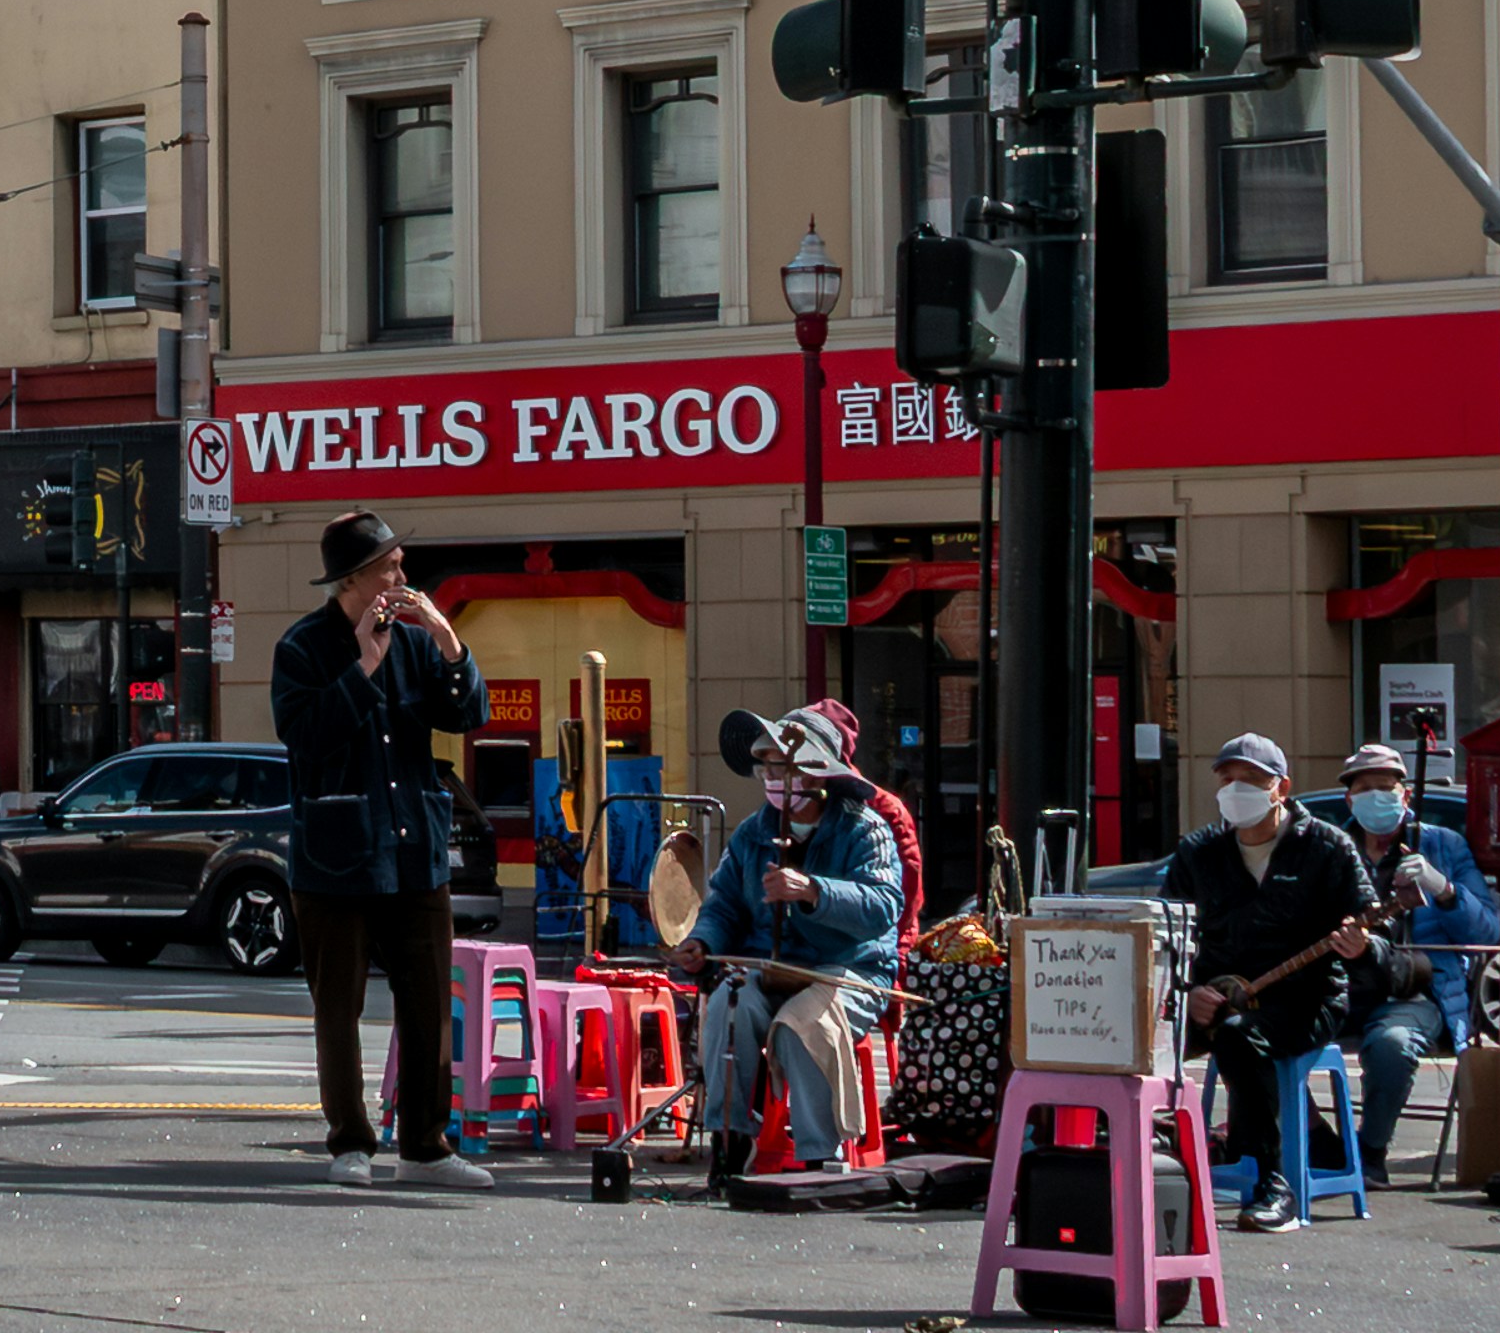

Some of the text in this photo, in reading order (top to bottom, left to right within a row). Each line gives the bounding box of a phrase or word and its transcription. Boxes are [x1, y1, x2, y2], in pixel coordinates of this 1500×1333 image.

[236, 384, 780, 474] WELLS FARGO
[190, 494, 229, 511] ON RED
[129, 682, 166, 700] PEN
[488, 688, 533, 704] ELLS
[1032, 938, 1085, 963] Thank
[1034, 970, 1103, 988] Donation
[1030, 1022, 1054, 1035] Have
[1059, 1026, 1066, 1035] a
